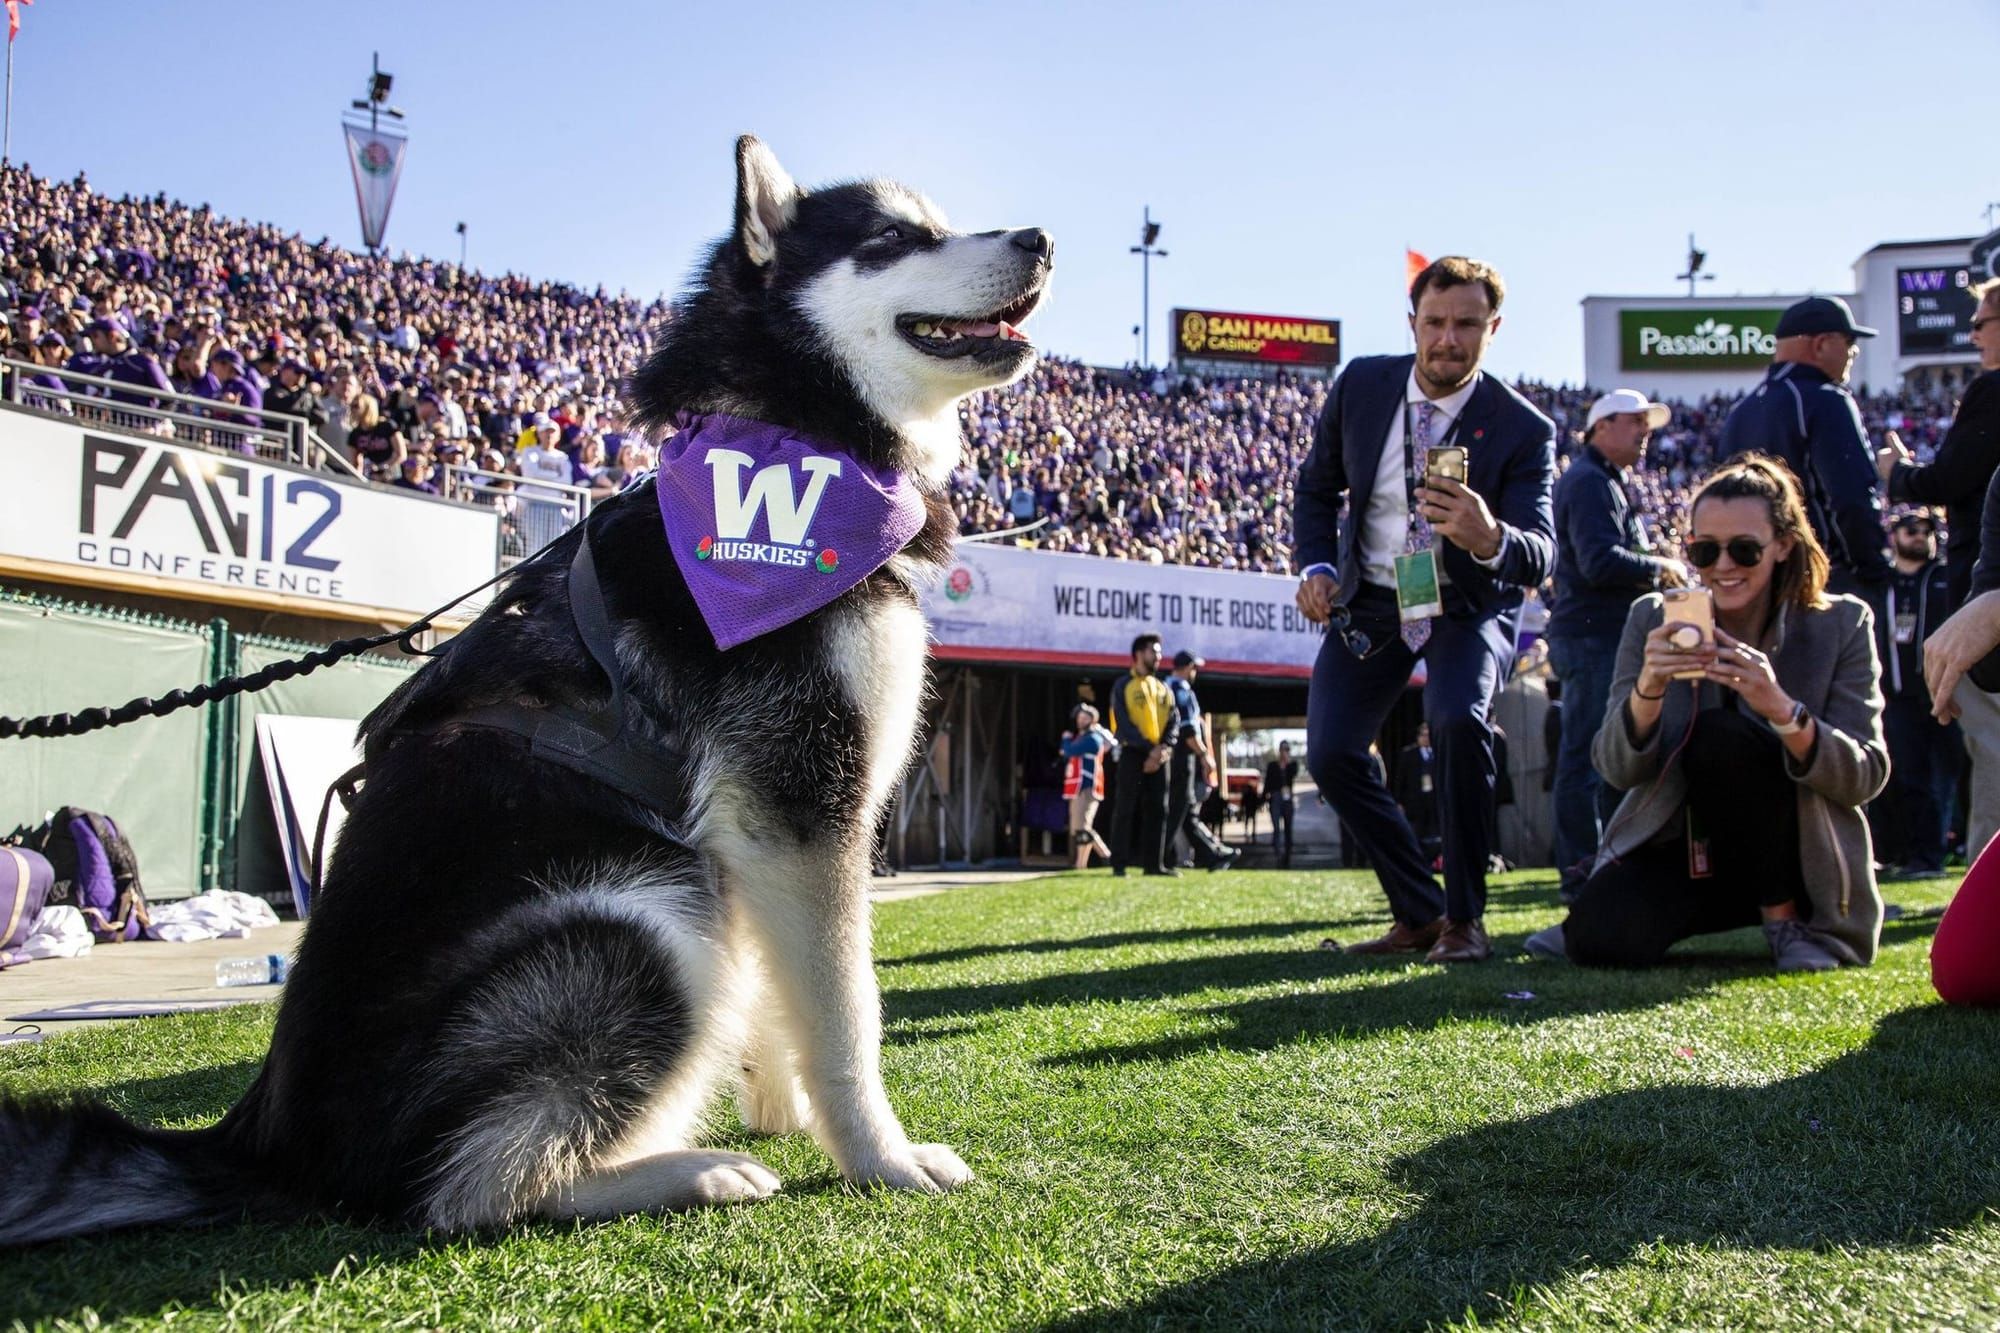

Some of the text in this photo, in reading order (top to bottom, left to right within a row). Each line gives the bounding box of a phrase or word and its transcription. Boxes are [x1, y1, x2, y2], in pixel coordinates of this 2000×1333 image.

[1207, 335, 1261, 353] CASINO
[1208, 317, 1337, 345] SAN MANUEL
[1639, 326, 1777, 355] Passion Ro
[703, 448, 842, 546] W
[78, 541, 344, 598] CONFERENCE
[712, 543, 809, 567] HUSKIES
[1054, 584, 1326, 635] WELCOME TO THE ROSE BO
